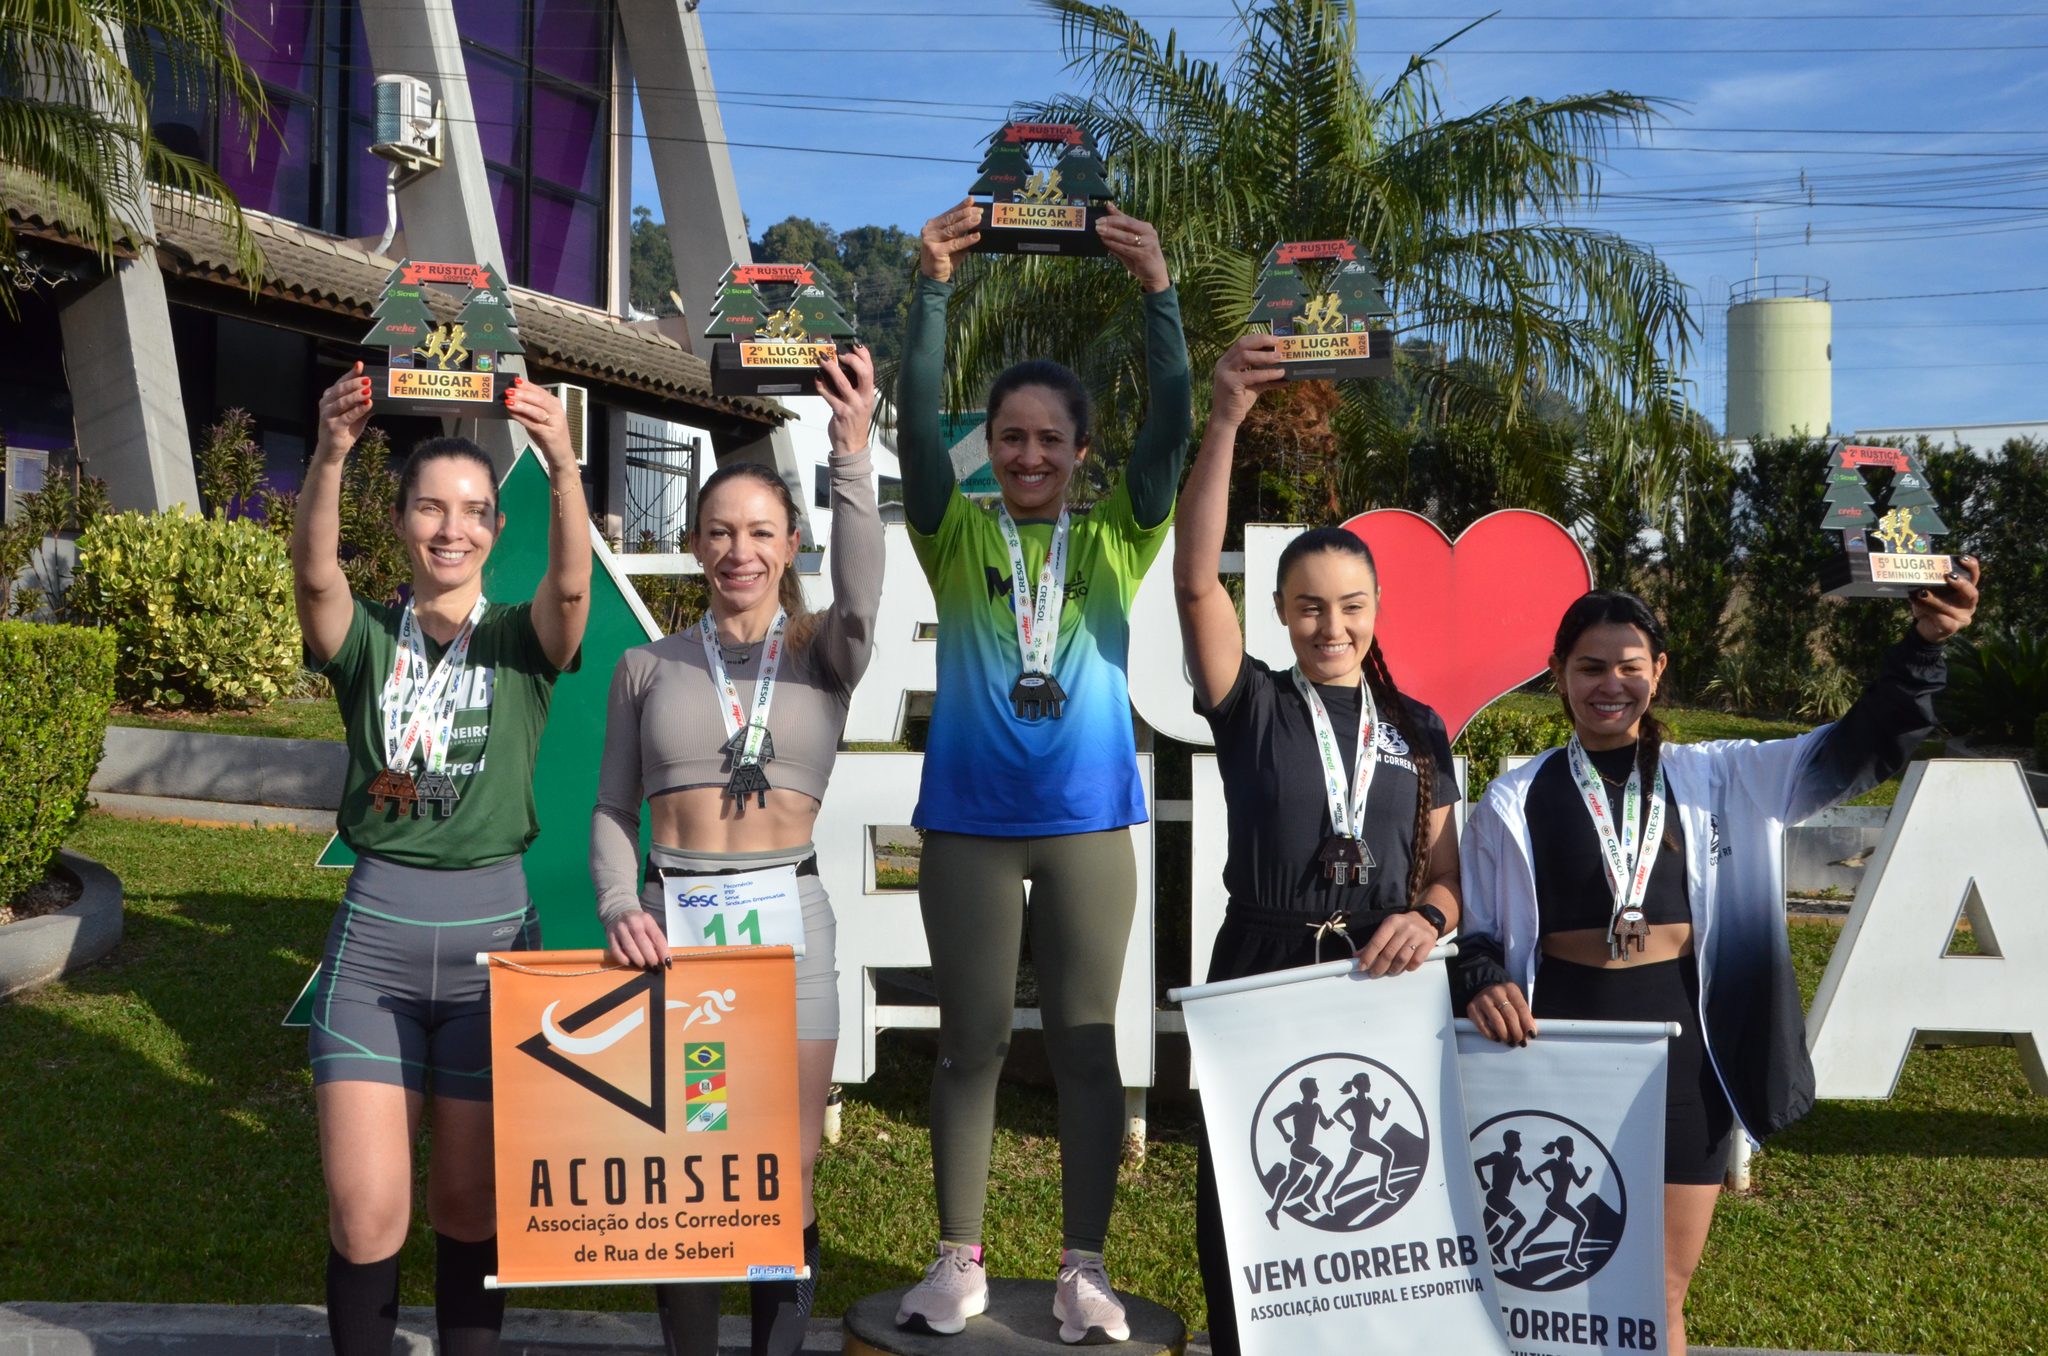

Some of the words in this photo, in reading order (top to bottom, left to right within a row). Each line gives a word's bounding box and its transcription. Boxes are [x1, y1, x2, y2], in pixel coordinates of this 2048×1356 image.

[996, 217, 1048, 226] FEMININO
[1050, 219, 1073, 228] 3KM
[1018, 207, 1067, 218] LUGAR
[768, 346, 817, 356] LUGAR
[1301, 337, 1350, 349] LUGAR
[1334, 348, 1356, 357] 3KM
[746, 357, 800, 365] FEMININO
[394, 386, 451, 397] FEMININO
[454, 388, 479, 398] 3KM
[418, 374, 472, 388] LUGAR
[482, 376, 490, 399] 2026
[1014, 558, 1026, 594] CRESOL
[1877, 570, 1921, 580] FEMININO
[1894, 558, 1936, 570] LUGAR
[1036, 585, 1048, 624] CRESOL
[1022, 614, 1031, 645] creluz
[768, 640, 778, 661] creluz
[394, 657, 405, 686] creluz
[758, 676, 770, 708] CRESOL
[390, 708, 398, 730] Sesc
[404, 720, 420, 750] creluz
[1325, 742, 1336, 770] Sicredi
[1384, 754, 1412, 771] CORRER
[1588, 793, 1604, 817] creluz
[1626, 793, 1636, 821] Sicredi
[1647, 804, 1660, 841] CRESOL
[1607, 838, 1624, 878] CRESOL
[1635, 864, 1647, 896] creluz
[678, 893, 718, 908] Sesc
[704, 909, 762, 947] 11
[530, 1153, 780, 1208] ACORSEB
[526, 1214, 628, 1236] Associação
[635, 1212, 669, 1229] dos
[676, 1209, 781, 1228] Corredores
[574, 1244, 598, 1262] de
[604, 1245, 639, 1262] Rua
[645, 1243, 668, 1261] de
[675, 1242, 735, 1260] Seberi
[1243, 1258, 1307, 1295] VEM
[1314, 1241, 1430, 1286] CORRER
[1436, 1234, 1479, 1269] RB
[1251, 1296, 1330, 1322] ASSOCIAÇÃO
[1333, 1290, 1398, 1310] CULTURAL
[1401, 1287, 1408, 1300] E
[1412, 1278, 1484, 1300] ESPORTIVA
[1502, 1306, 1608, 1347] ORRER
[1618, 1316, 1656, 1351] RB
